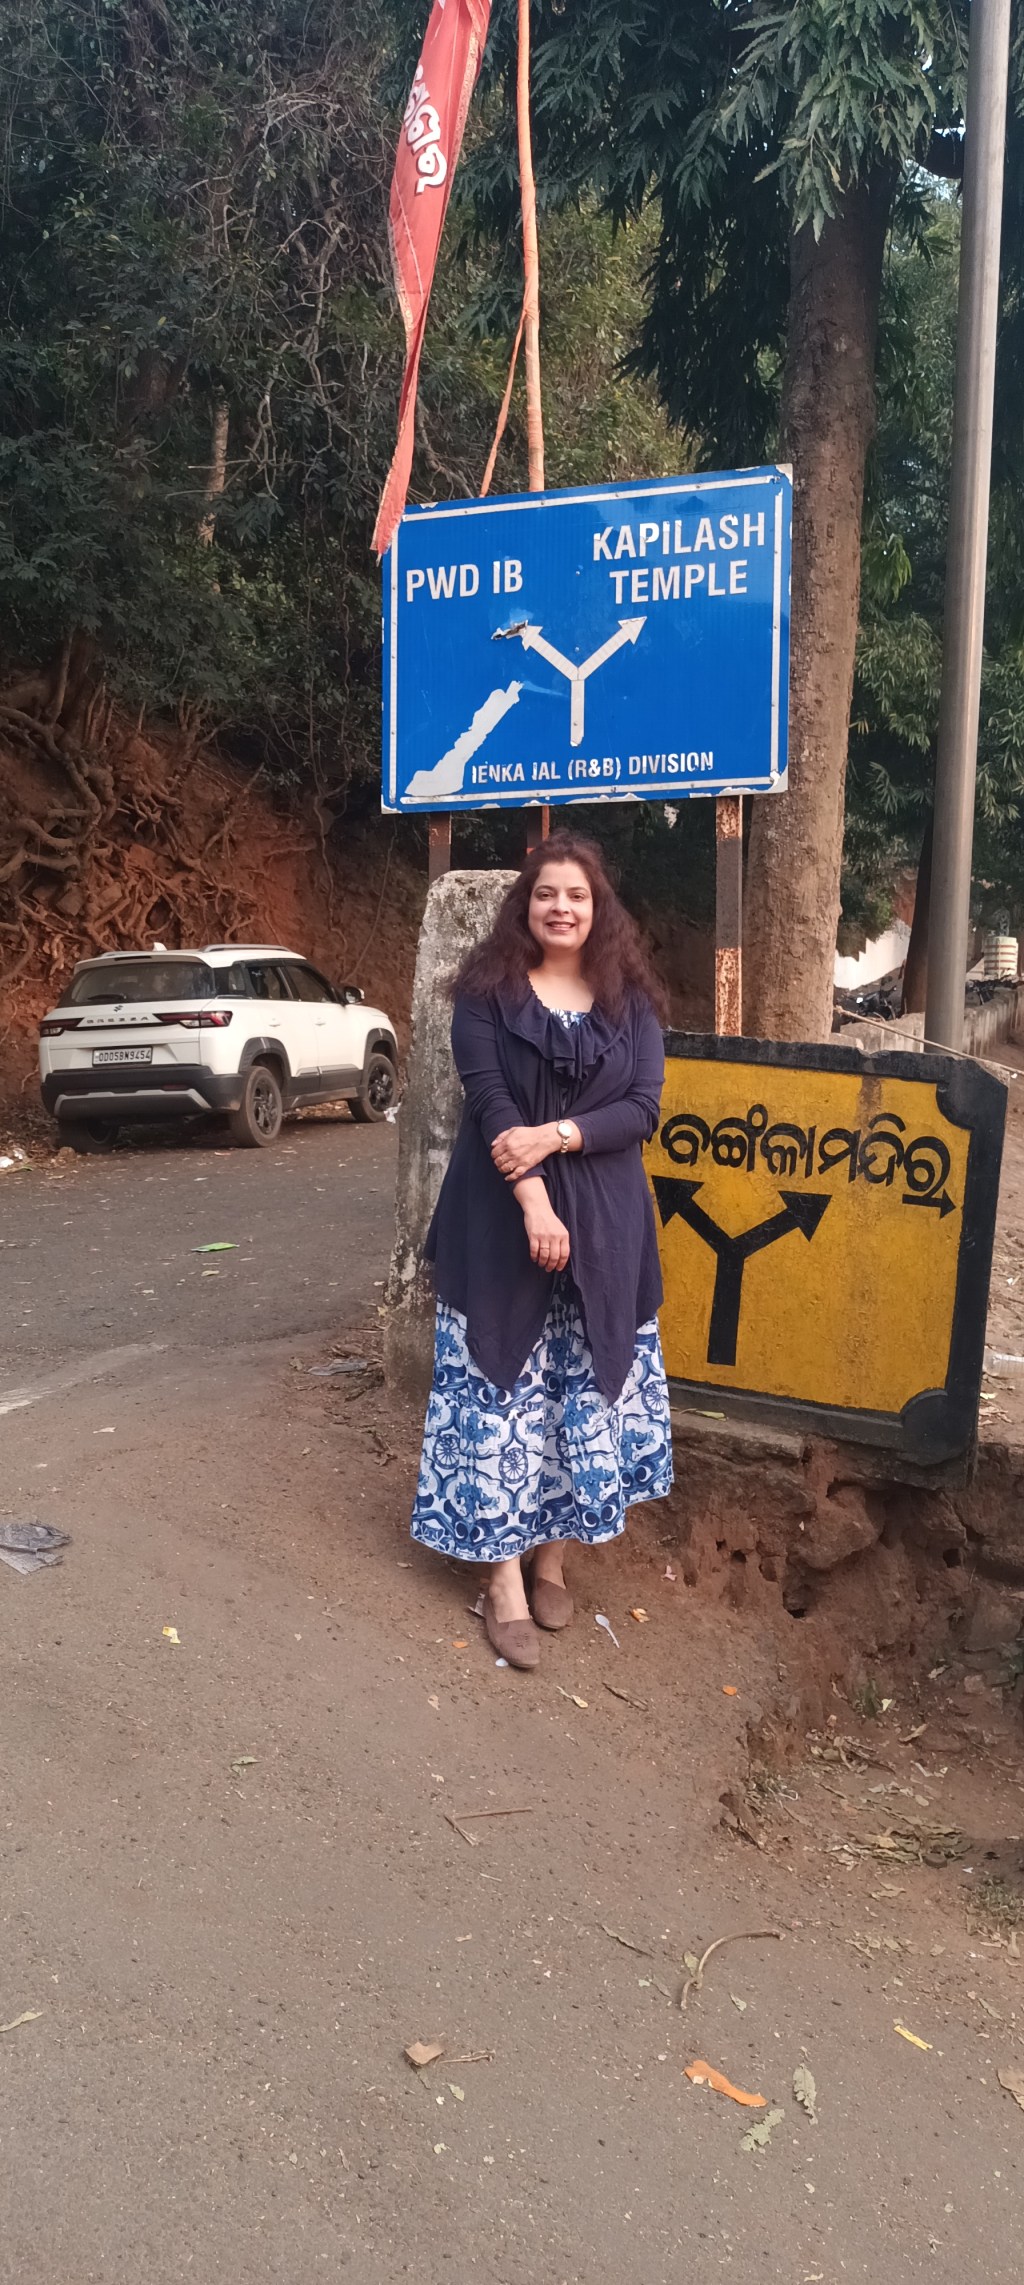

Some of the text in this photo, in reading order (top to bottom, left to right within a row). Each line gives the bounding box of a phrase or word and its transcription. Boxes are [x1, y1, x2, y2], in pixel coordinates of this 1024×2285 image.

[592, 511, 766, 561] KAPILASH
[405, 559, 524, 602] PWD IB
[609, 559, 748, 604] TEMPLE
[567, 756, 622, 781] (R&B)
[628, 751, 714, 774] DIVISION
